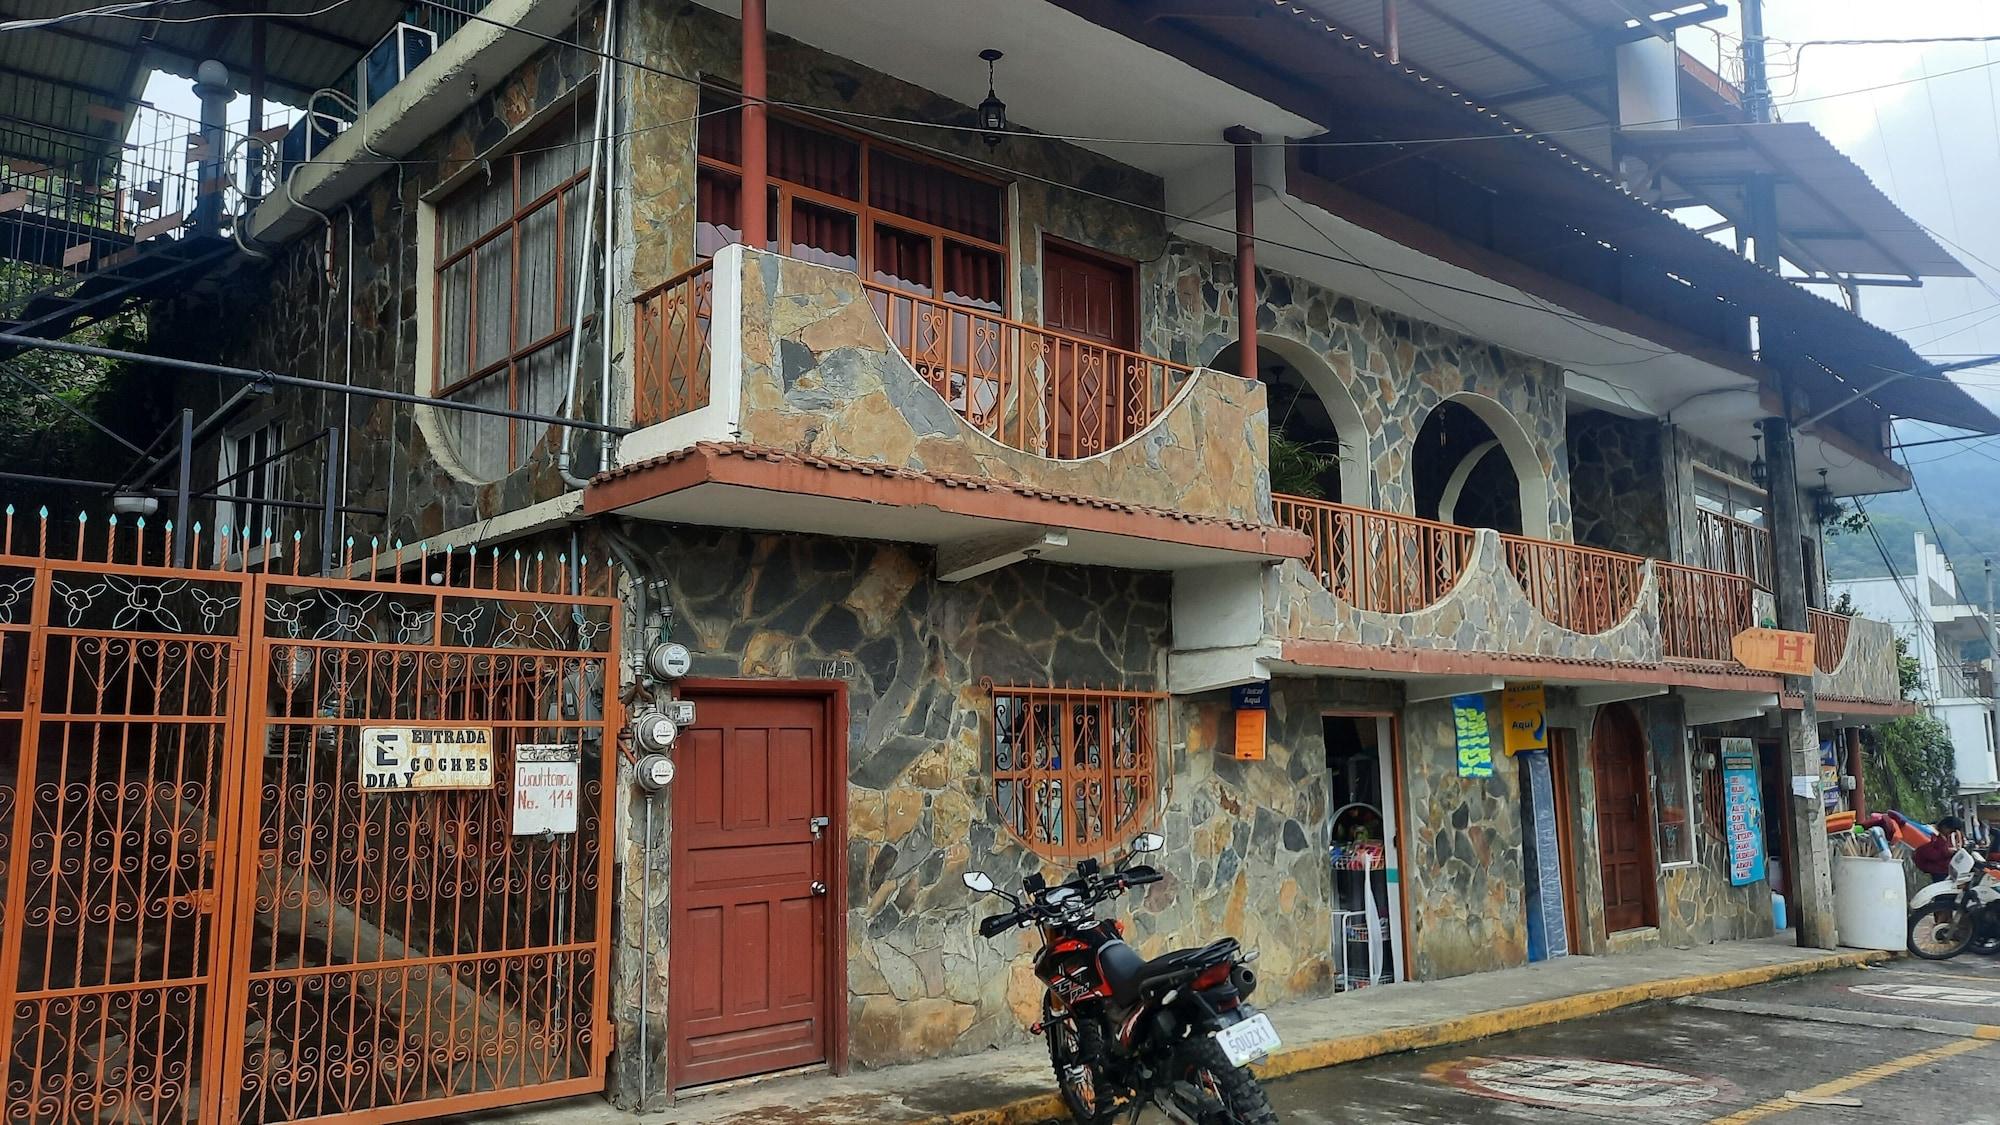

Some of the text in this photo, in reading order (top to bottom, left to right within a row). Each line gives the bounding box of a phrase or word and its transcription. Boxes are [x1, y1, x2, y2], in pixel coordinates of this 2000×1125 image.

[1776, 633, 1806, 662] H
[819, 660, 854, 679] 114-D
[411, 729, 487, 744] ENTRADA
[410, 757, 489, 773] COCHES
[365, 773, 399, 789] DIA
[403, 772, 415, 788] Y
[518, 789, 573, 810] No. 114
